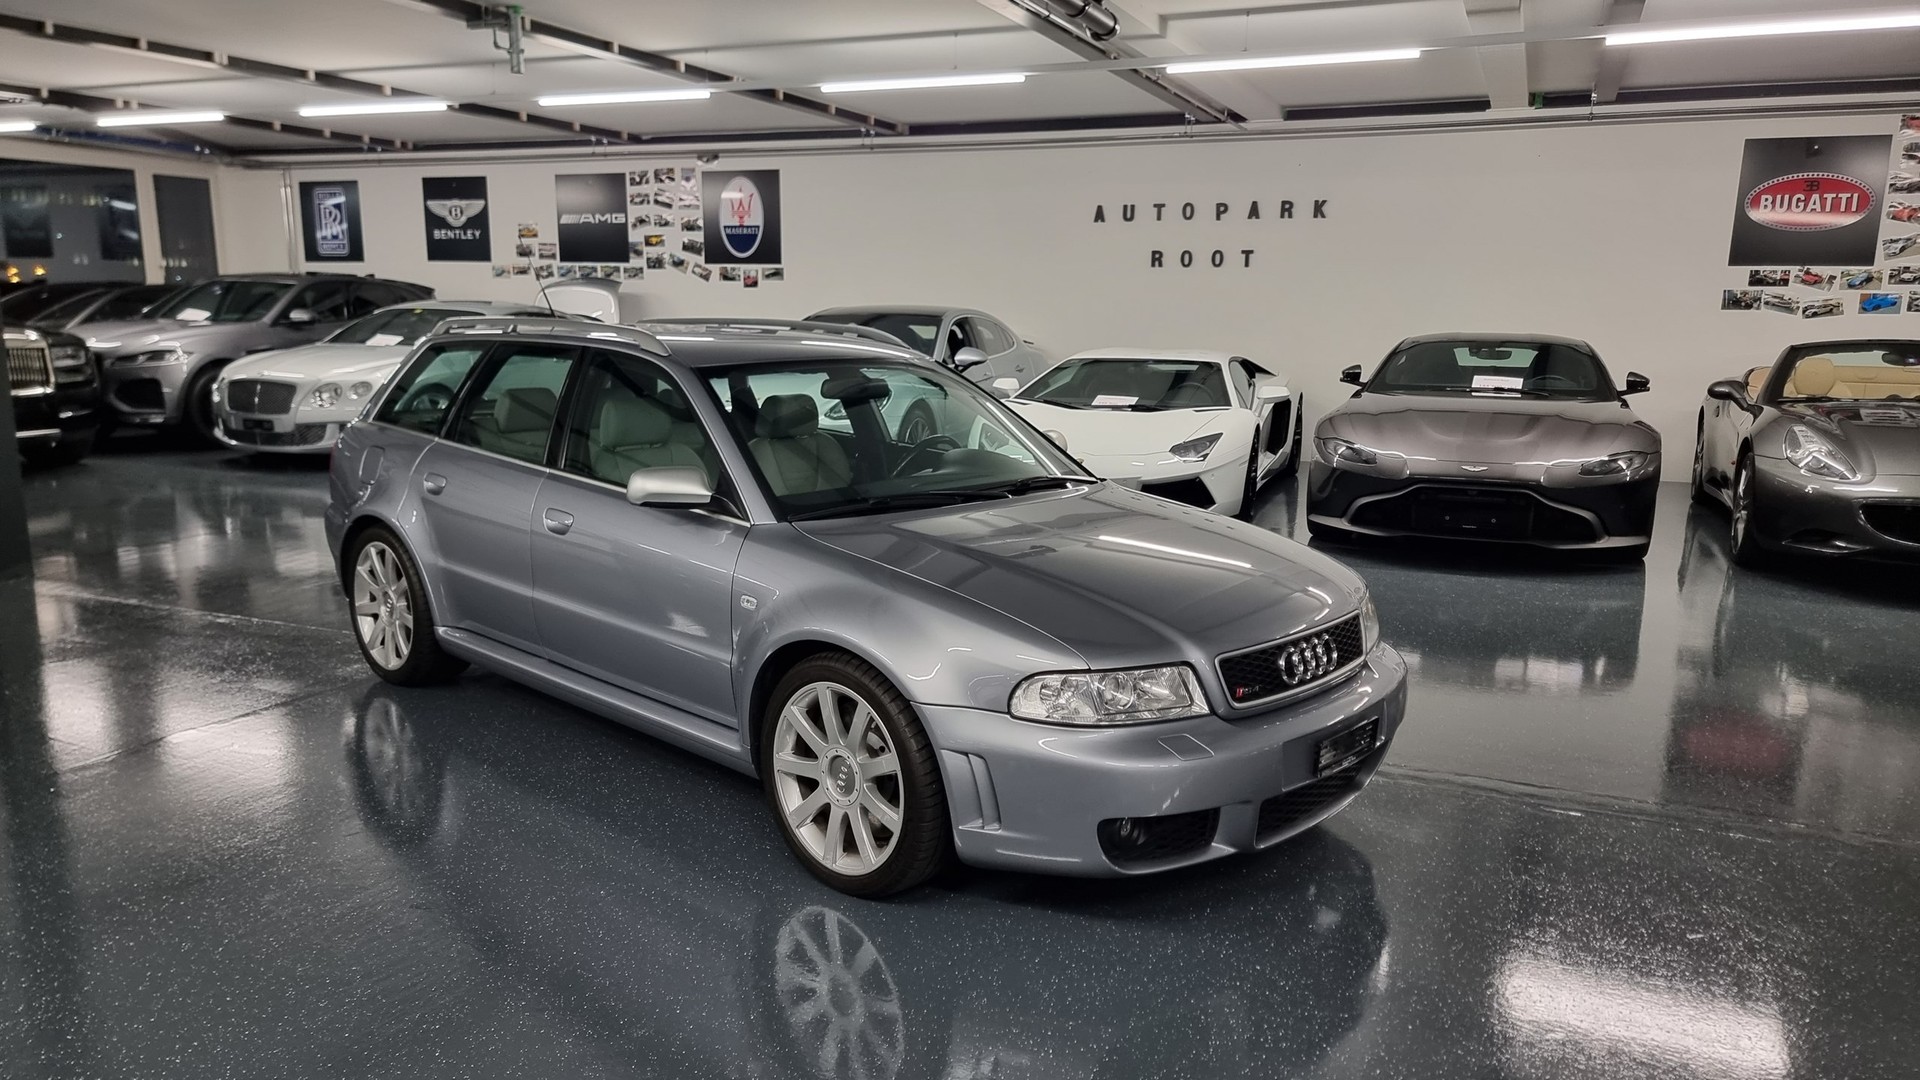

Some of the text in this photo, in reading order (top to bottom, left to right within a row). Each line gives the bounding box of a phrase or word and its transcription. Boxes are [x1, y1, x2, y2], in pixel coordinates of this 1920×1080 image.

[1758, 193, 1859, 213] BUGATTI
[579, 213, 626, 224] AMG
[1094, 200, 1327, 222] AUTOPARK
[433, 228, 481, 240] BENTLEY
[724, 227, 759, 235] MASERATI
[1150, 249, 1254, 268] ROOT
